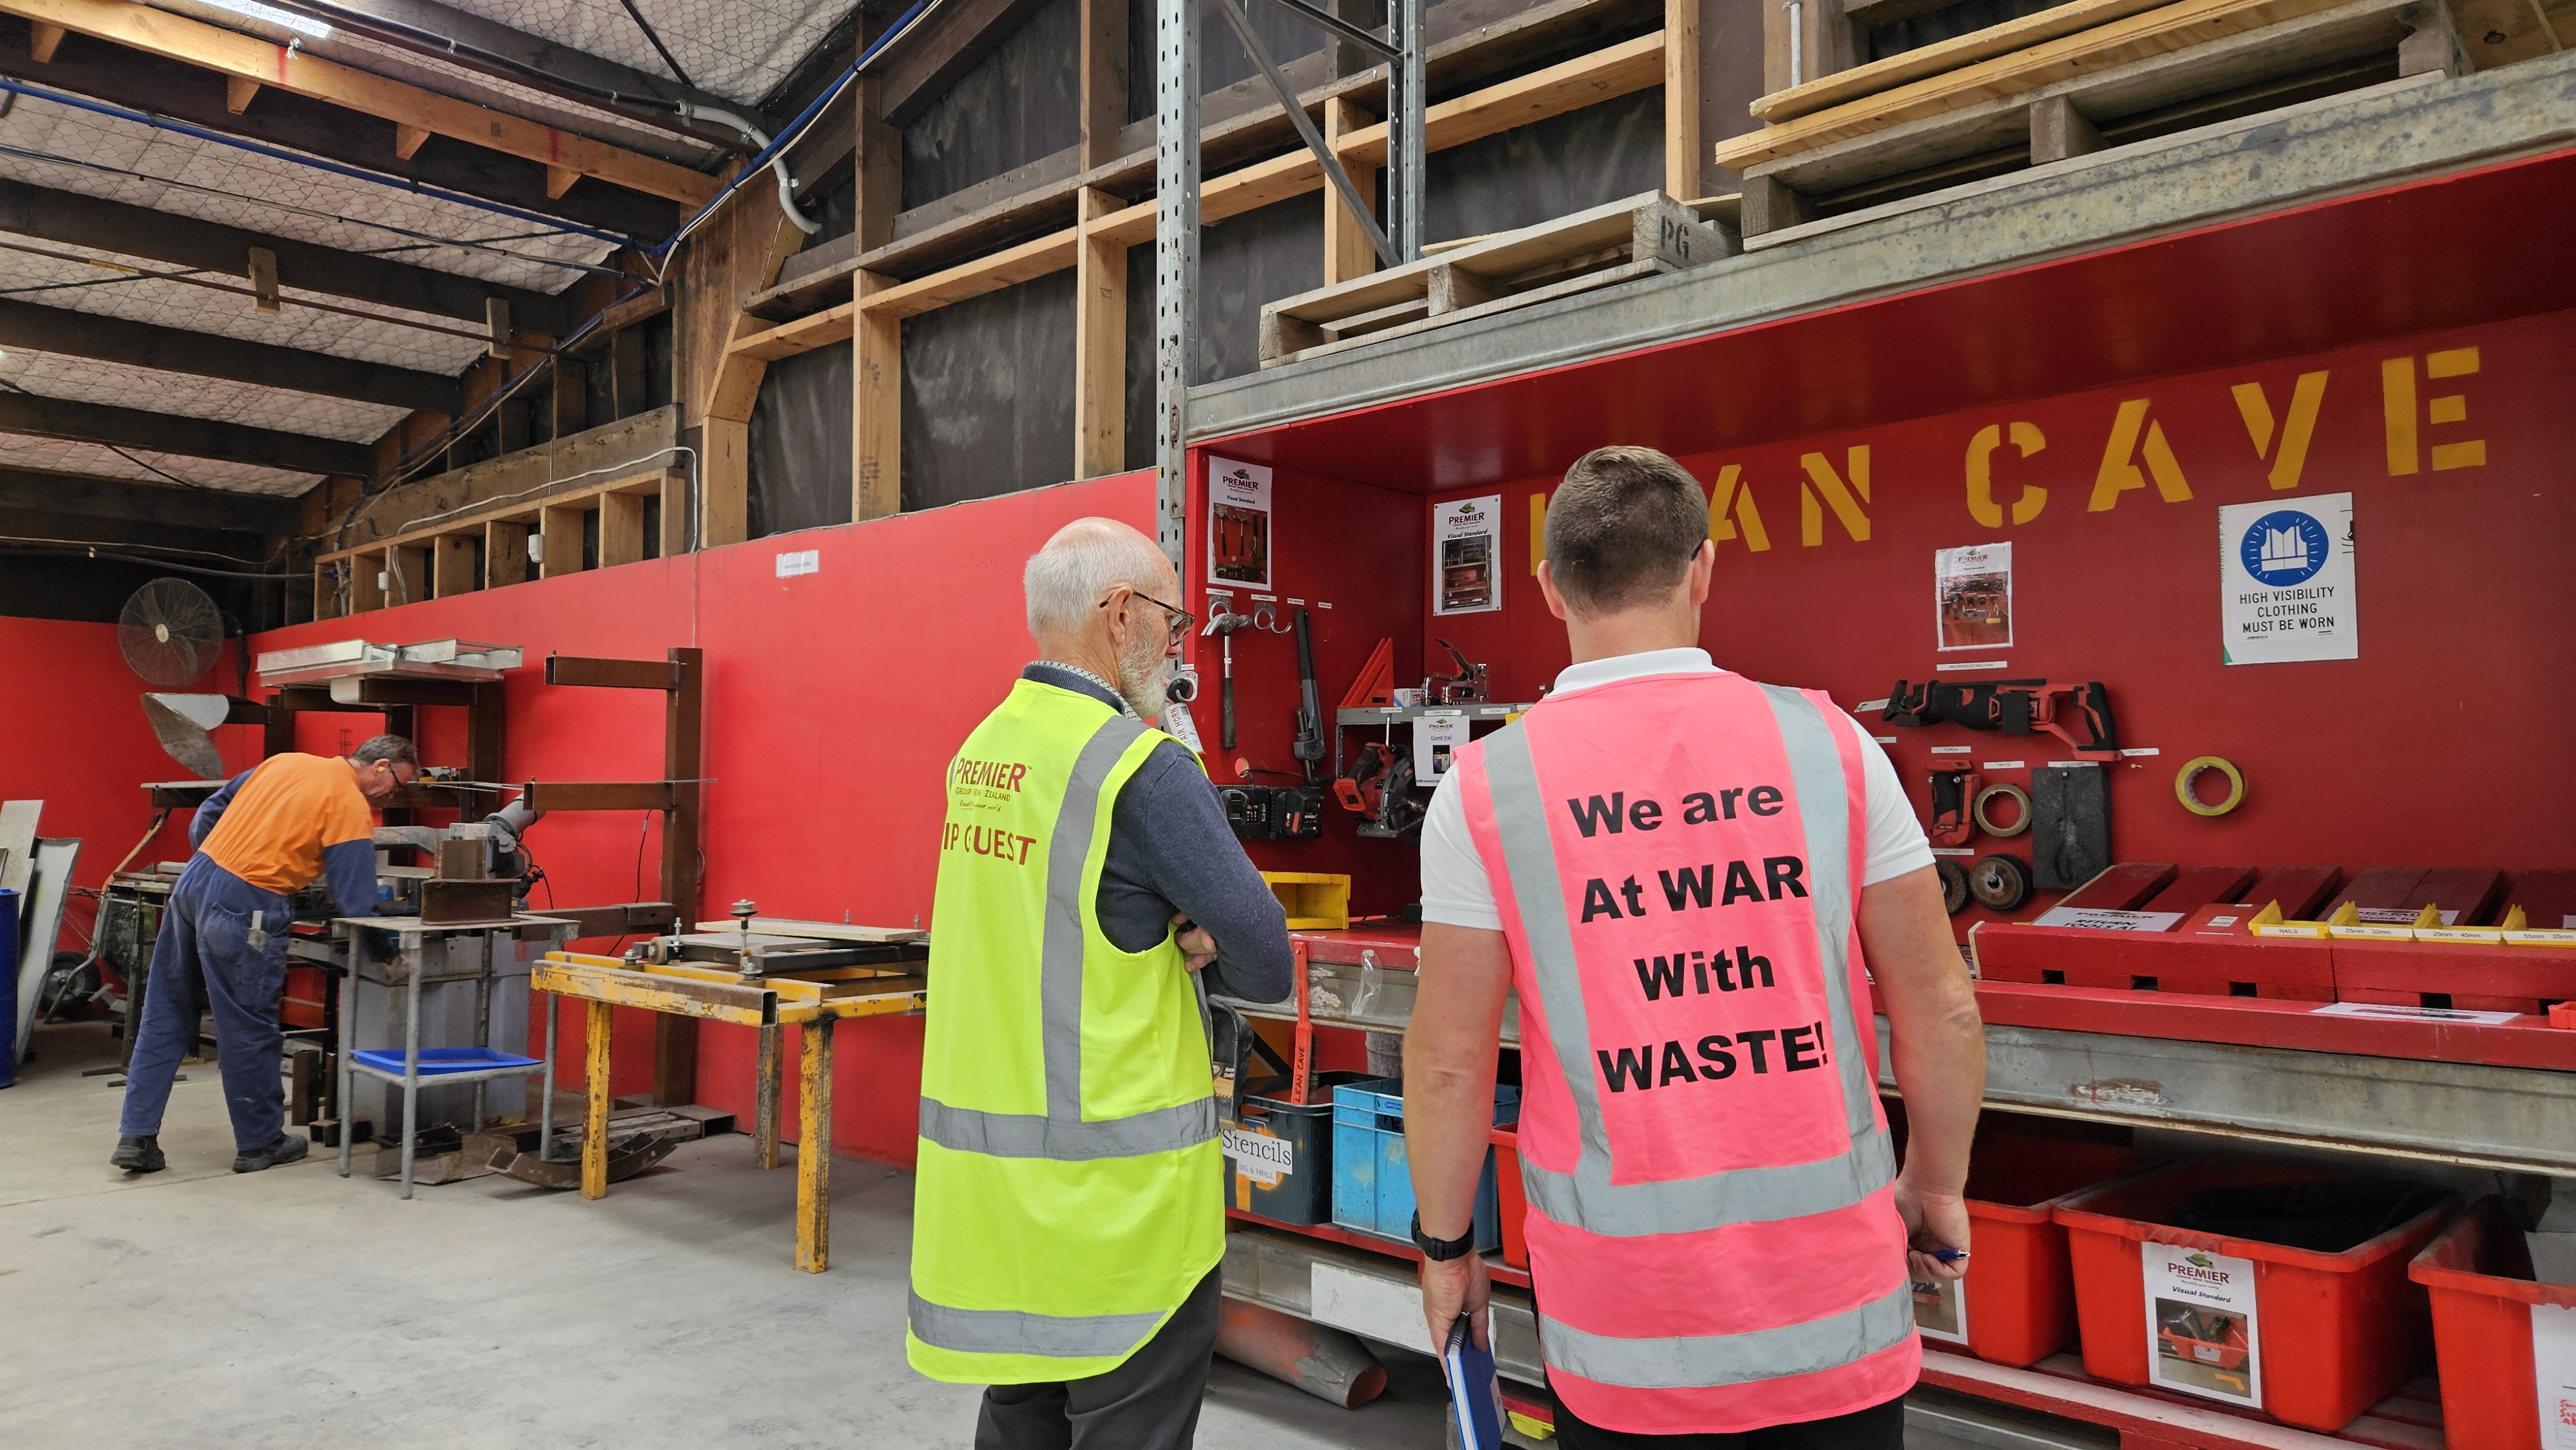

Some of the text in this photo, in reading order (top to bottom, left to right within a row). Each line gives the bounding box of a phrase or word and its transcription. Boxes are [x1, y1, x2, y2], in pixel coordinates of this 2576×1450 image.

[1661, 214, 1689, 260] PG
[1965, 346, 2486, 529] CAVE
[1223, 476, 1258, 489] PREMIER
[1448, 511, 1485, 525] PREMIER
[1463, 528, 1488, 537] Standard
[1958, 554, 1988, 563] PREMIER
[2239, 586, 2335, 605] HIGH VISIBILITY
[2257, 603, 2318, 618] CLOTHING
[2242, 616, 2334, 634] MUST BE WORN
[1170, 707, 1188, 740] AIR HORN
[953, 757, 1027, 793] PREMIER
[955, 787, 972, 795] GROUP
[984, 789, 1011, 802] ZEALAND
[1566, 784, 1785, 838] We are
[964, 824, 1037, 866] GUEST
[1580, 854, 1810, 924] At WAR
[1633, 945, 1776, 1002] With
[1596, 1020, 1829, 1093] WASTE!
[1294, 1075, 1303, 1103] LEAN
[1222, 1128, 1292, 1167] Stencils
[1238, 1163, 1248, 1172] BIG
[1255, 1168, 1274, 1180] SMALL
[2168, 1262, 2230, 1284] PREMIER
[2172, 1286, 2231, 1303] Visual Standard
